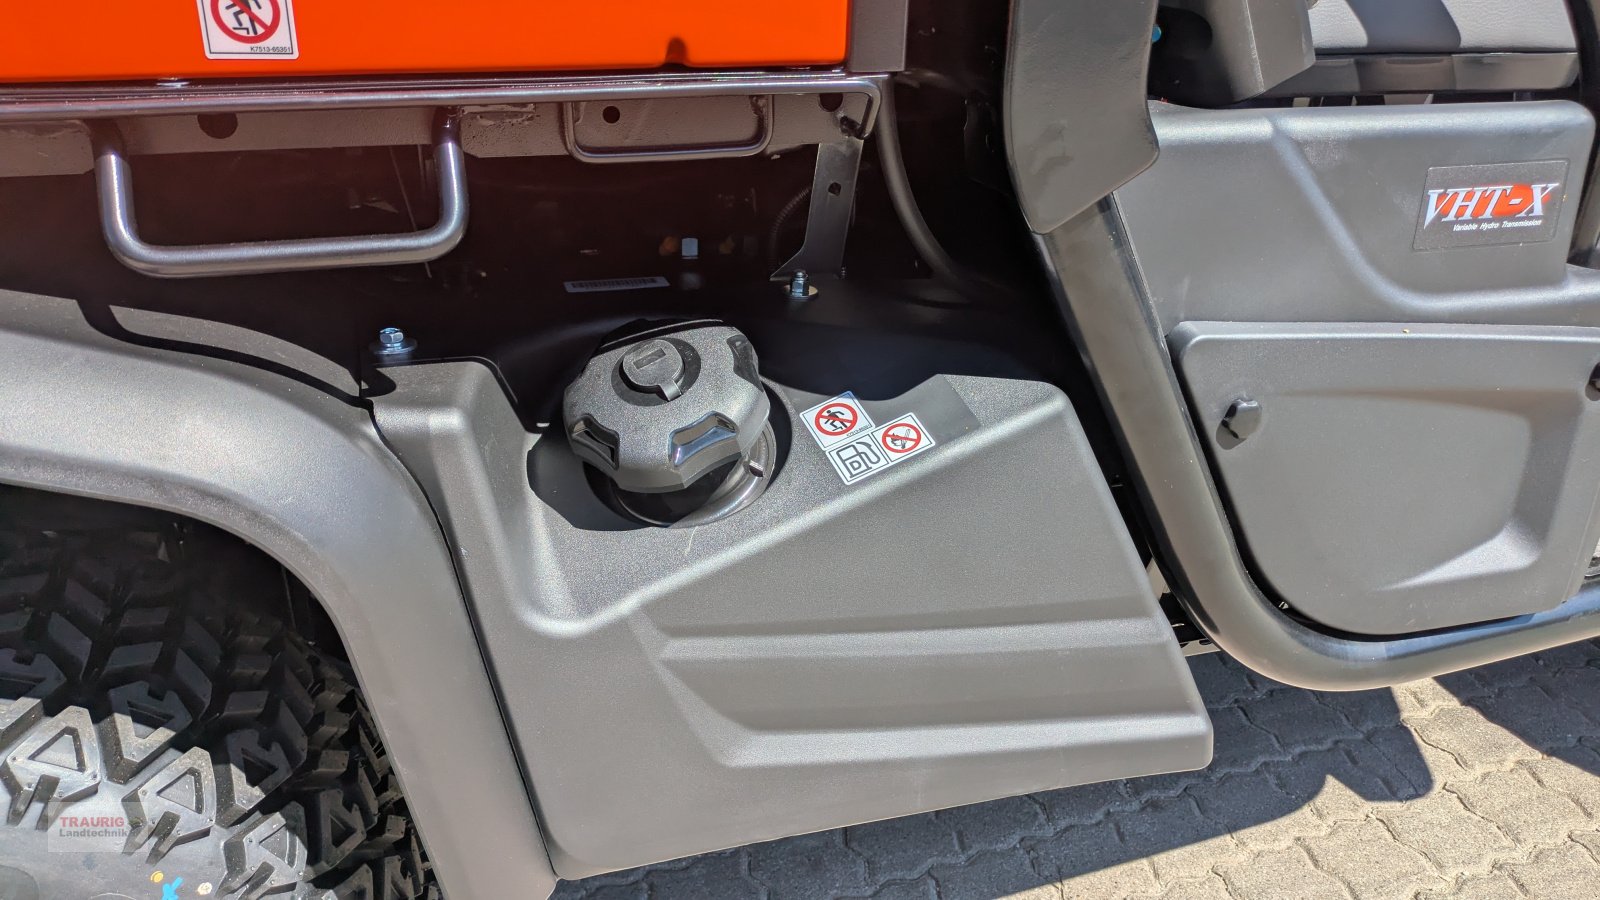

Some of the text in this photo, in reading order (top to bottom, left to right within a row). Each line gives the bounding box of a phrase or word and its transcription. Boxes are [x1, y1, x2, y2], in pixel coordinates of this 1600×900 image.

[1453, 219, 1542, 231] Variable Hydro Transmission
